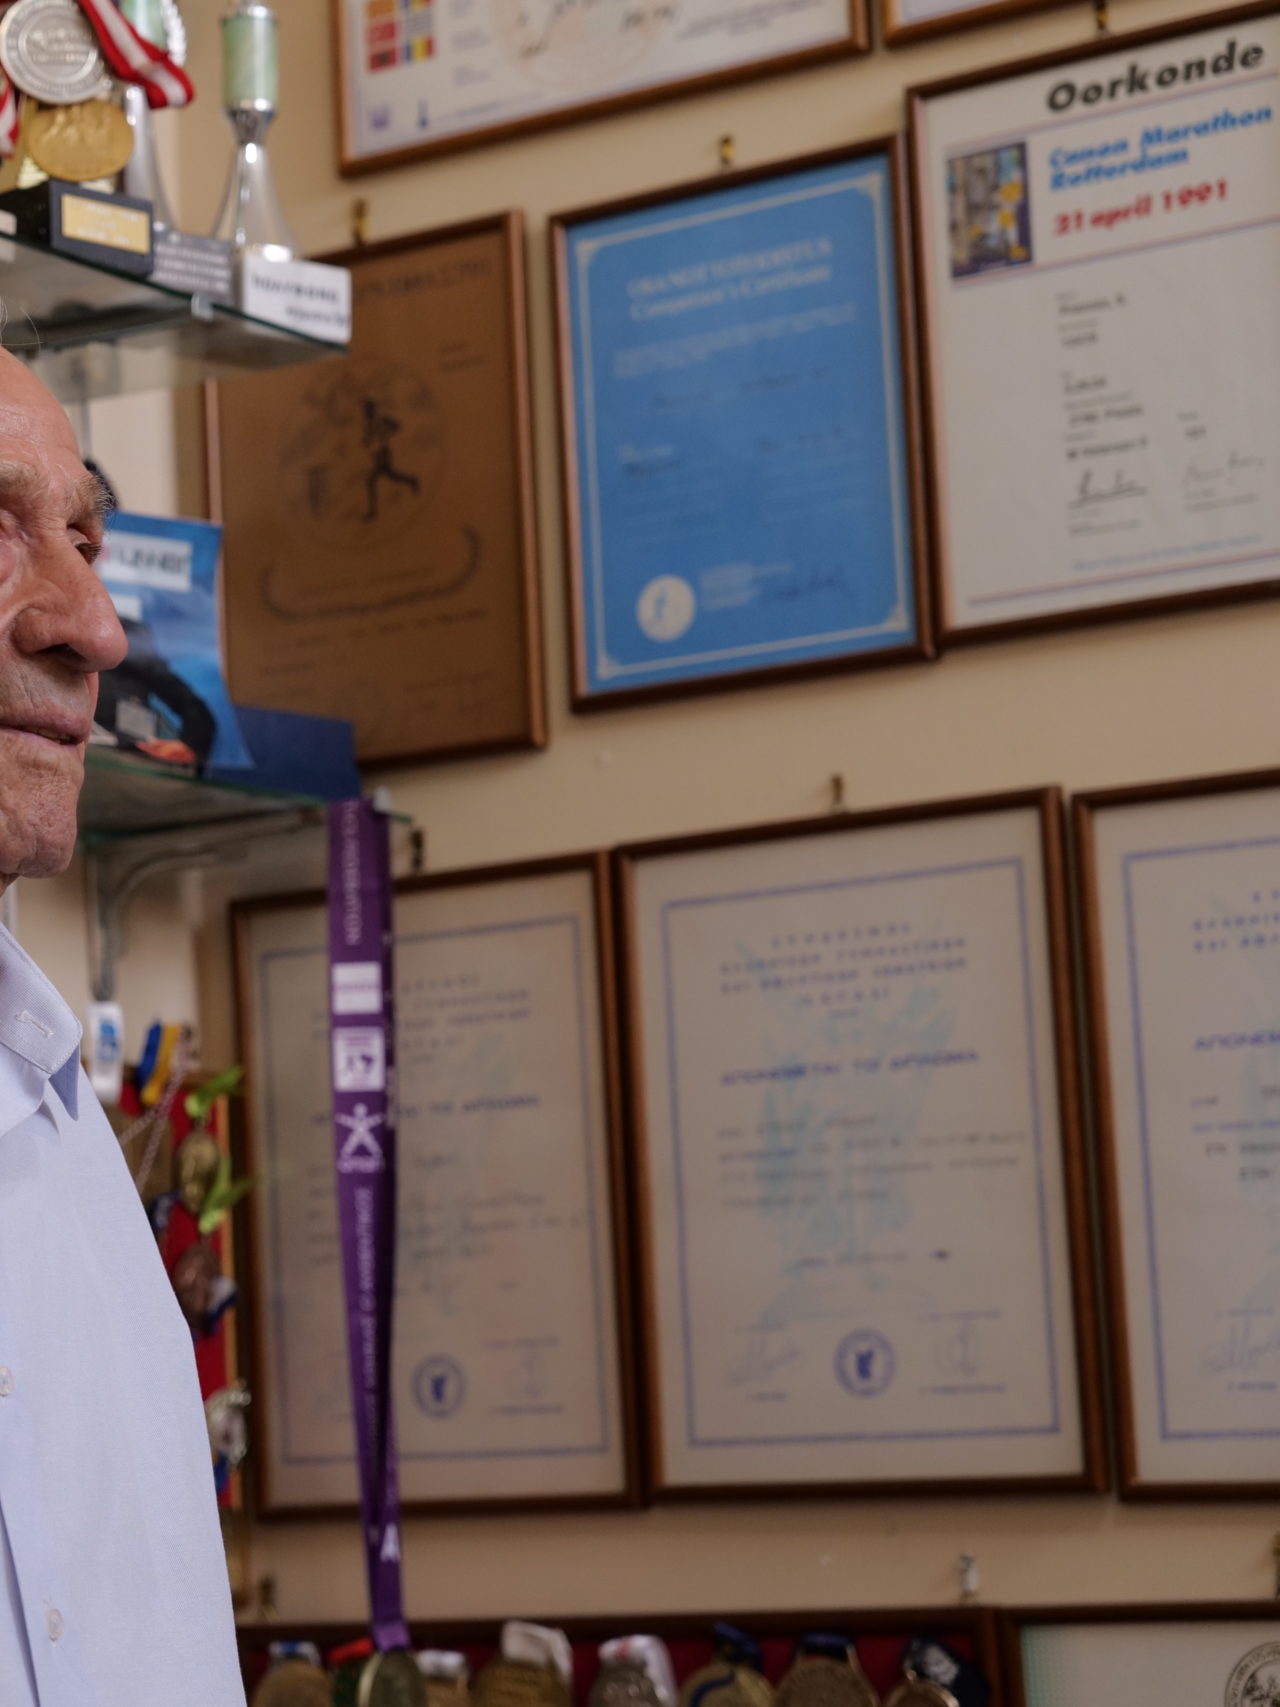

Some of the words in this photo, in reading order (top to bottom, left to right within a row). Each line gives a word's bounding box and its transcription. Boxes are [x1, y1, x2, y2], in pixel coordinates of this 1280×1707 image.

[1046, 39, 1265, 113] Oorkonde
[1140, 106, 1273, 147] Marathon
[1050, 149, 1189, 190] Rotterdam
[1089, 194, 1153, 228] april
